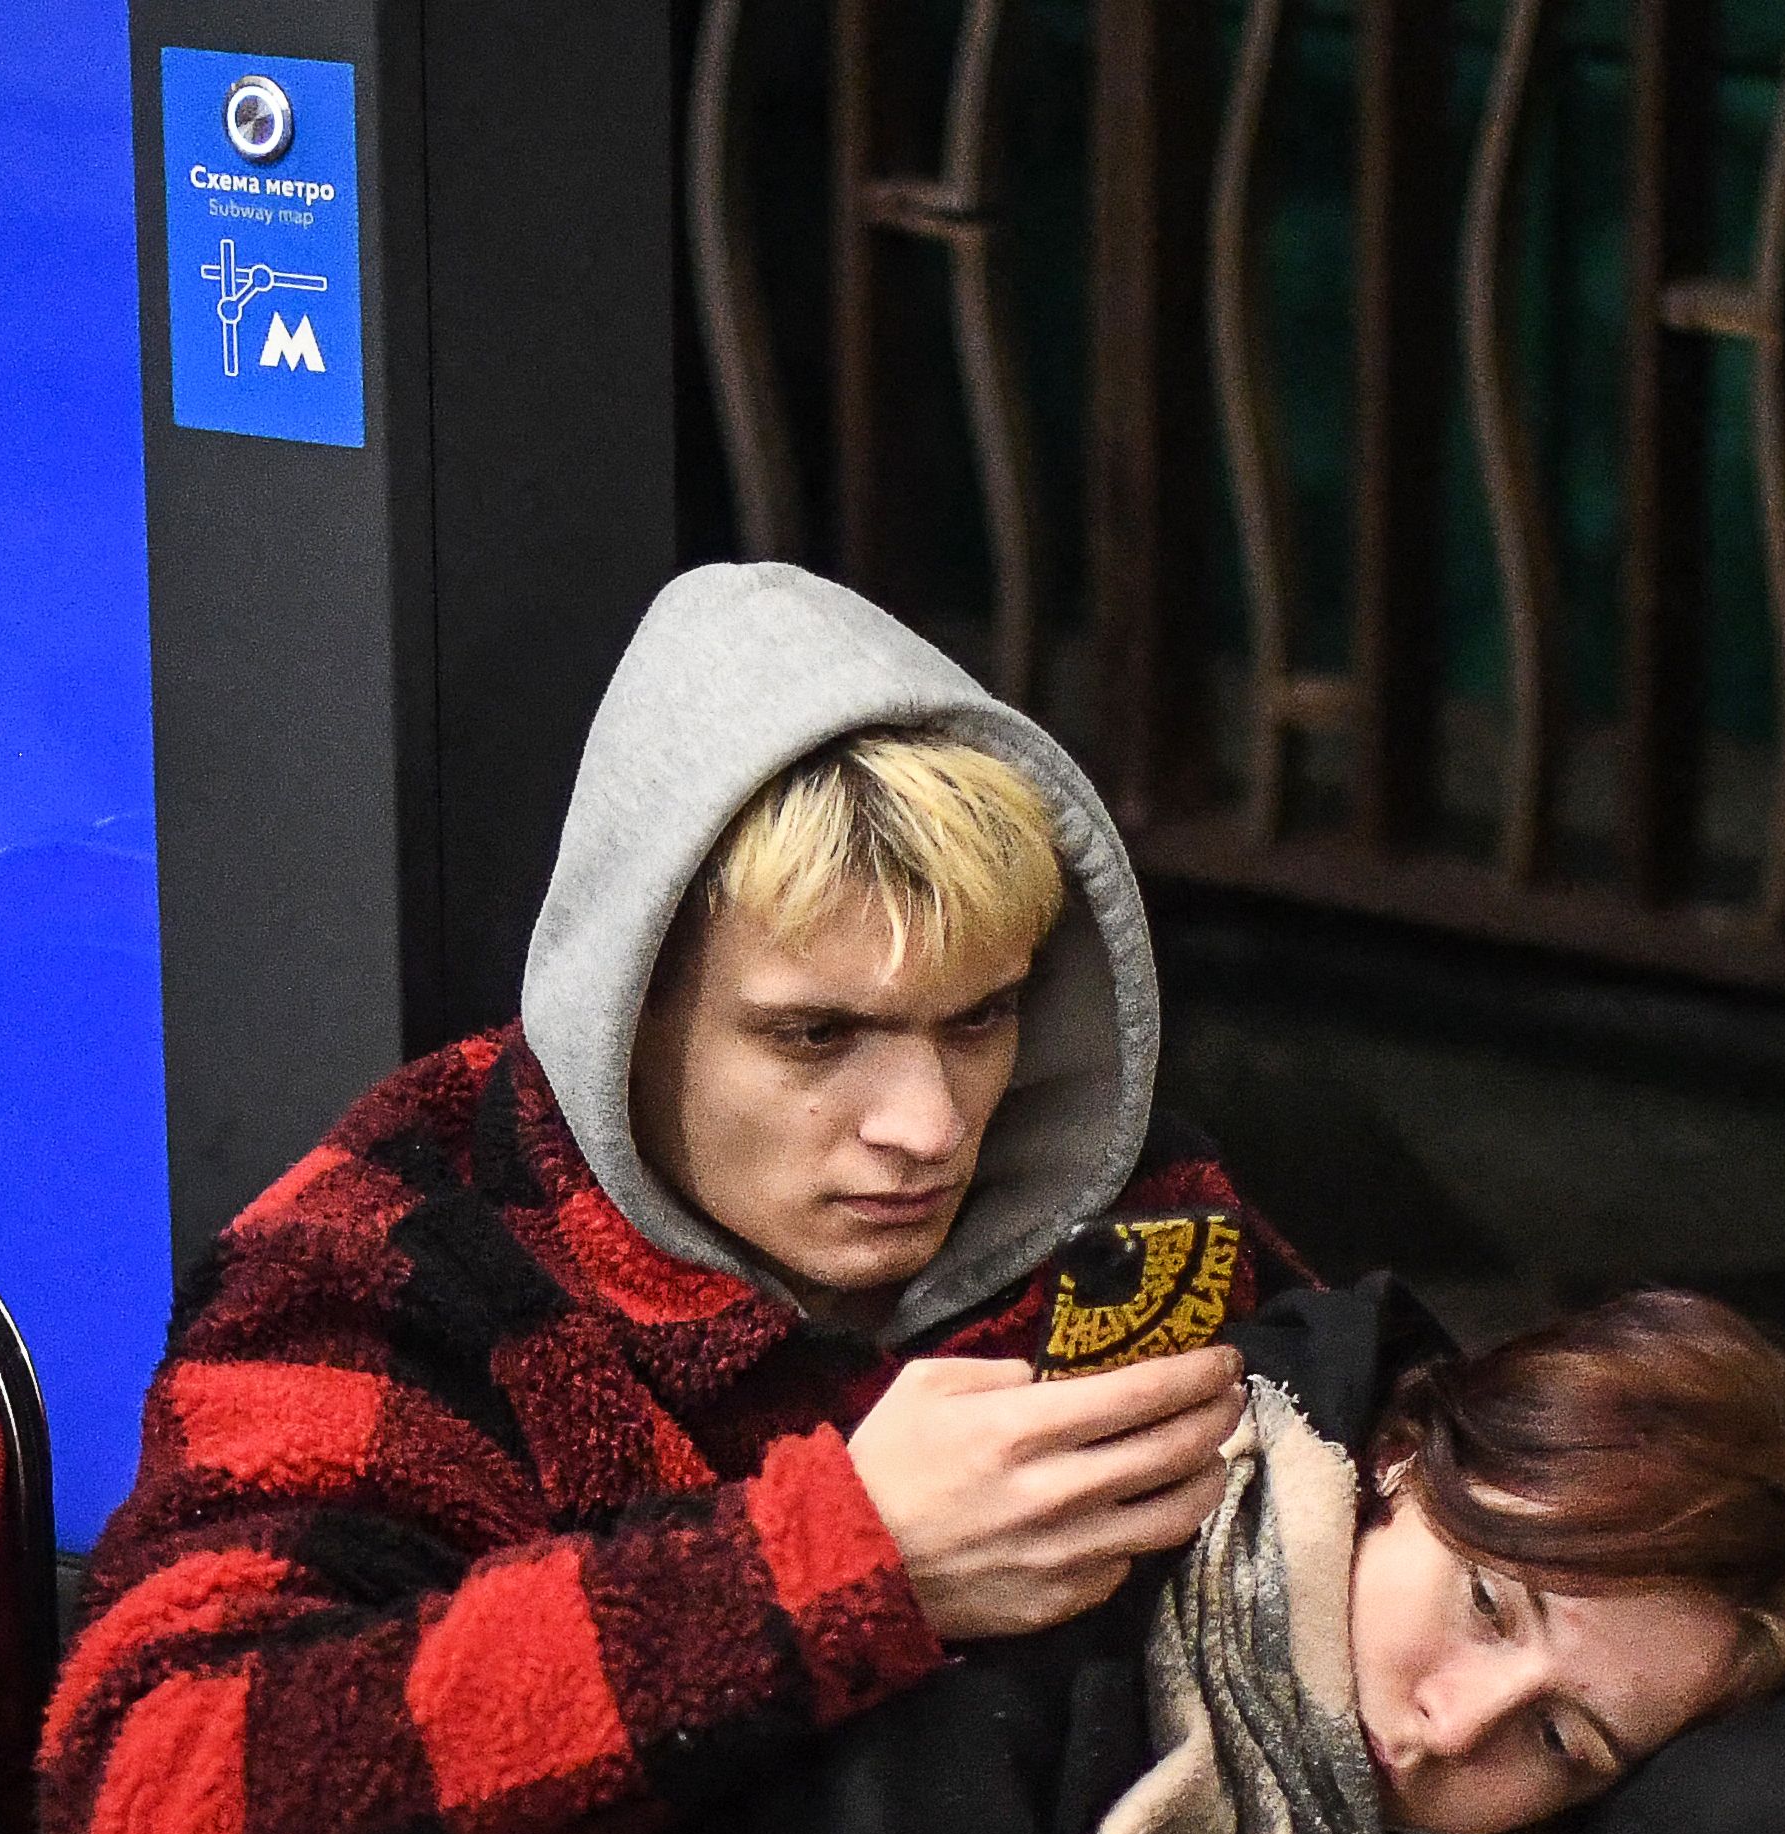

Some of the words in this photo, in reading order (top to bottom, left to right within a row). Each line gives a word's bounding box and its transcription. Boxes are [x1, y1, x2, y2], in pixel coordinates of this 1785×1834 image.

[189, 165, 260, 195] Схема
[266, 178, 335, 206] метро
[208, 199, 272, 226] Subway
[278, 209, 314, 227] map
